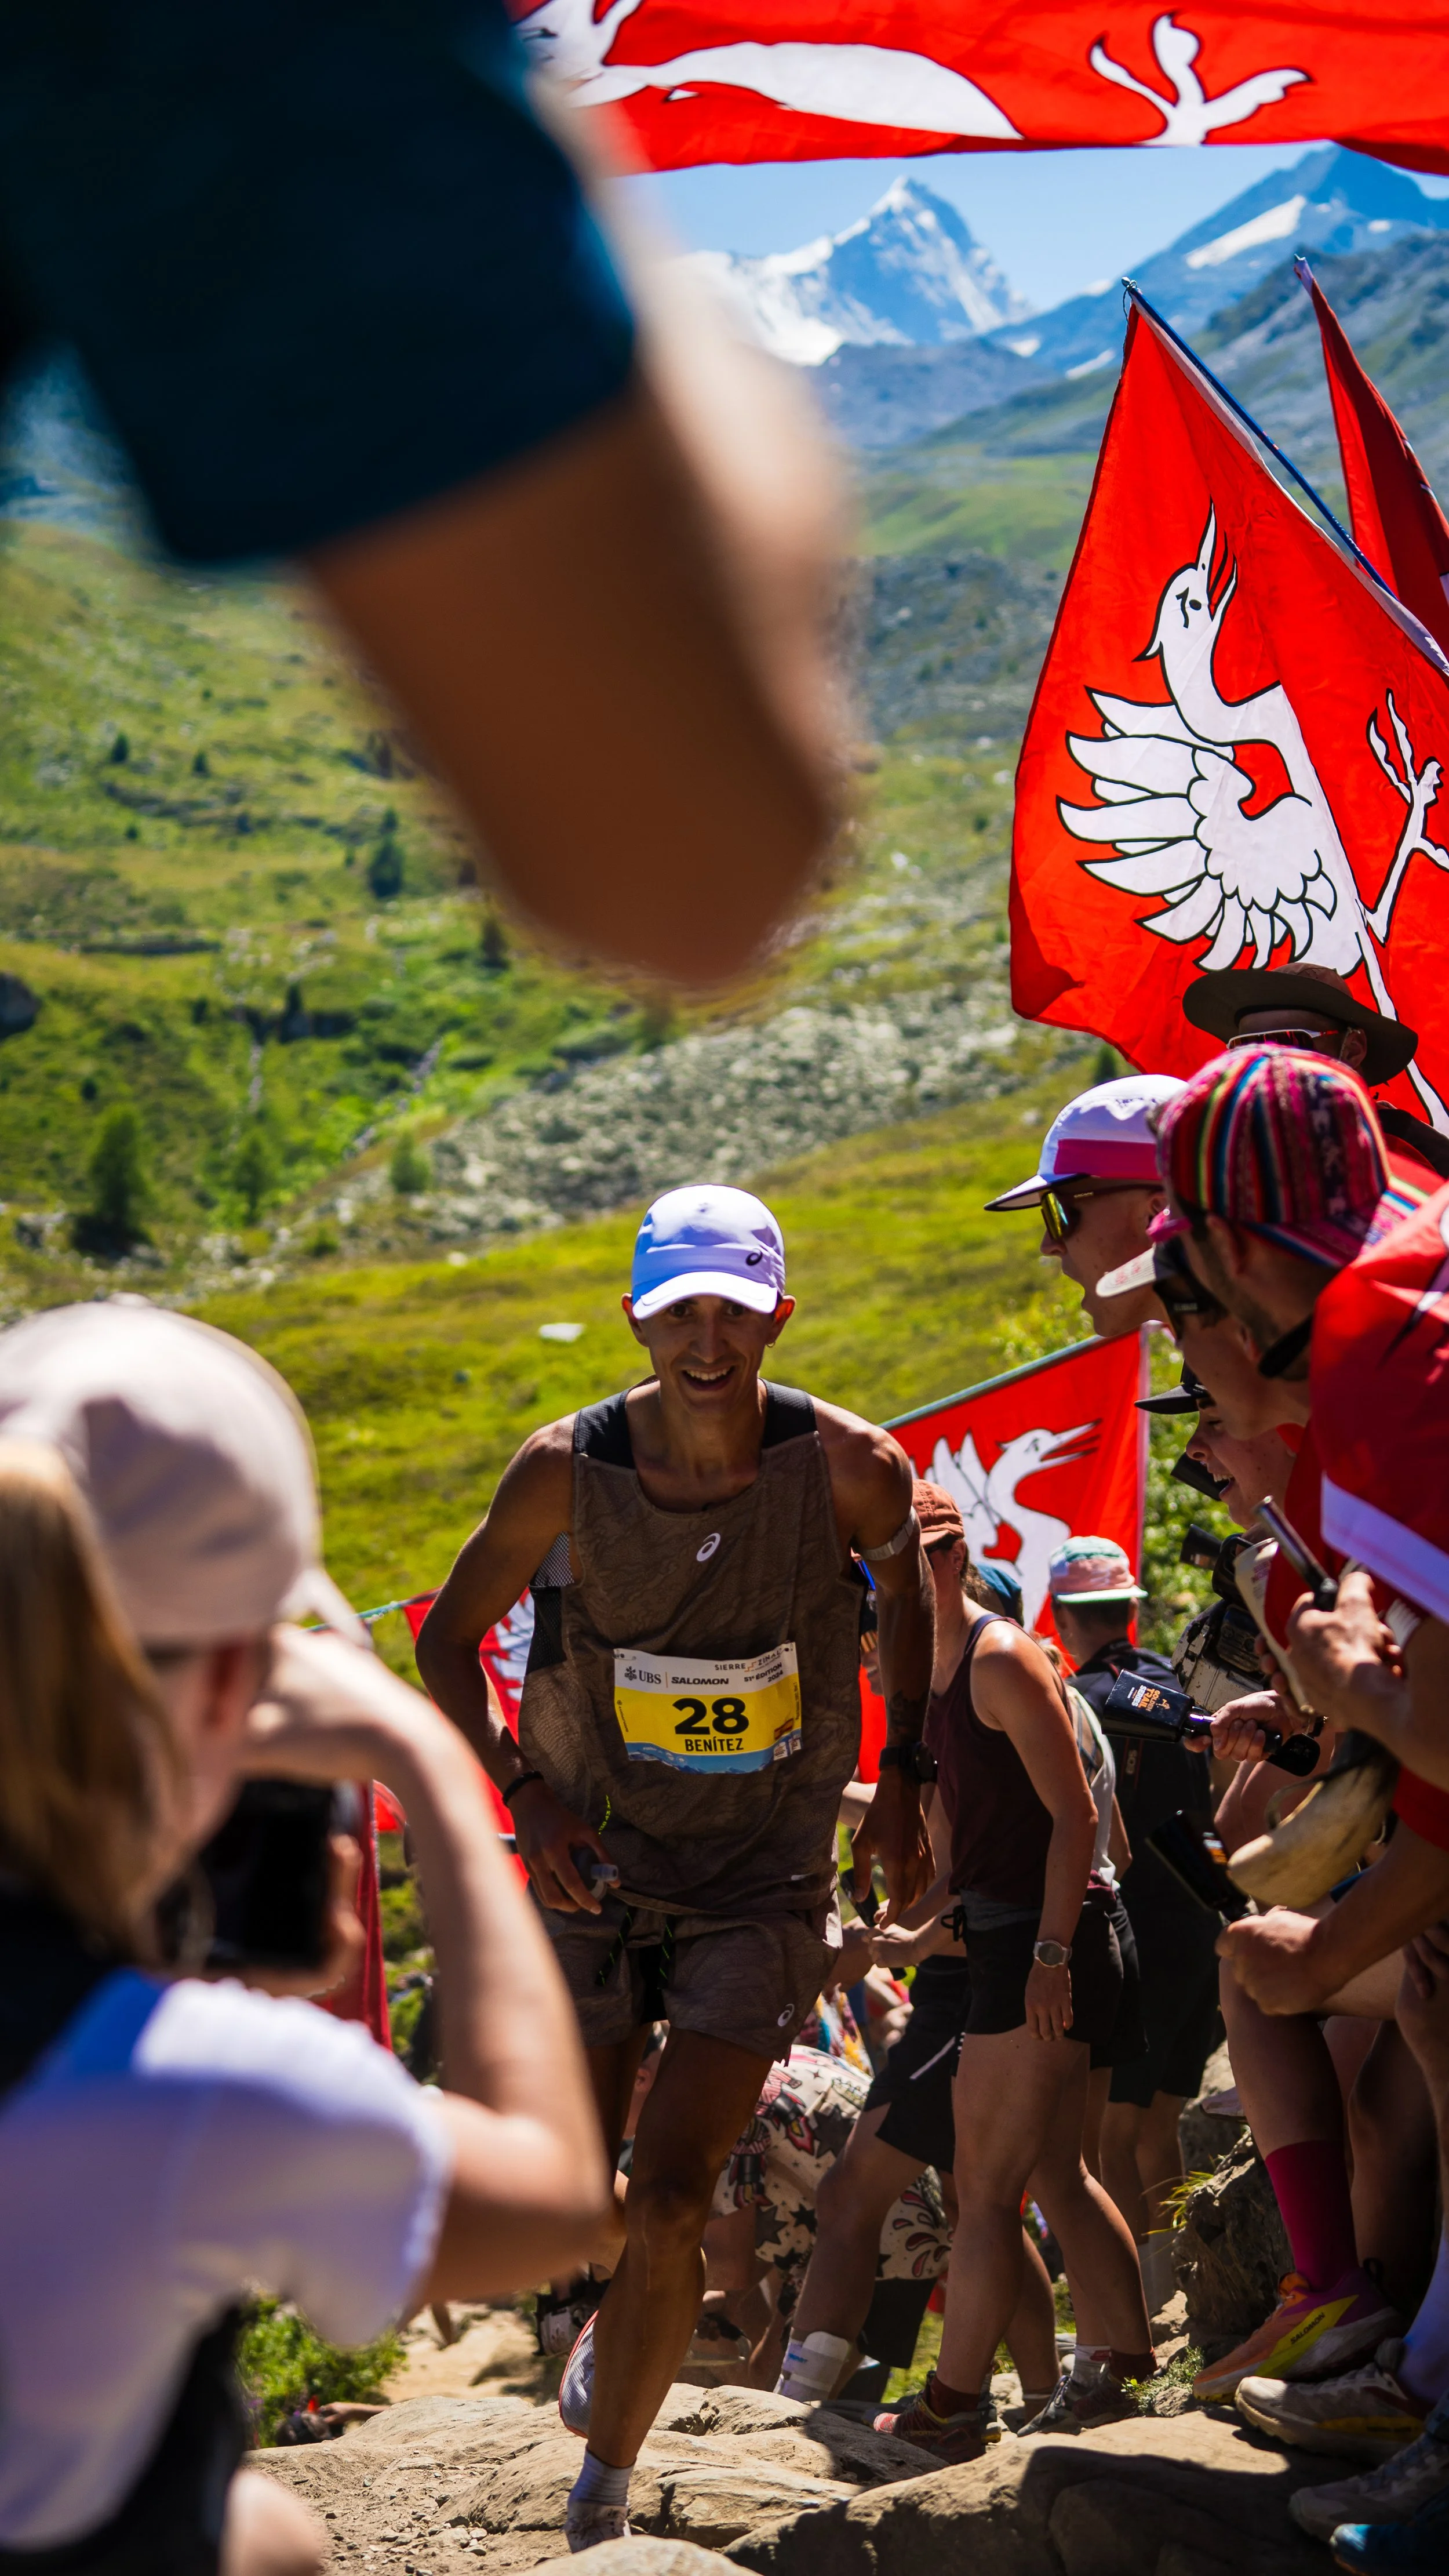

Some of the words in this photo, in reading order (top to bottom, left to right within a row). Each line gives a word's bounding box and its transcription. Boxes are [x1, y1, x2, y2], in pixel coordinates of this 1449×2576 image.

[758, 1650, 781, 1666] ZINAL
[639, 1670, 661, 1684] UBS
[756, 1662, 782, 1680] ÉDITION
[768, 1670, 783, 1683] 2024
[671, 1677, 729, 1685] SALOMON
[1131, 1685, 1147, 1707] SERIES
[1138, 1688, 1155, 1707] TRAIL
[1145, 1690, 1160, 1712] GOLDEN
[672, 1697, 749, 1734] 28
[685, 1736, 744, 1752] BENÍTEZ
[1290, 2312, 1326, 2345] SALOMON
